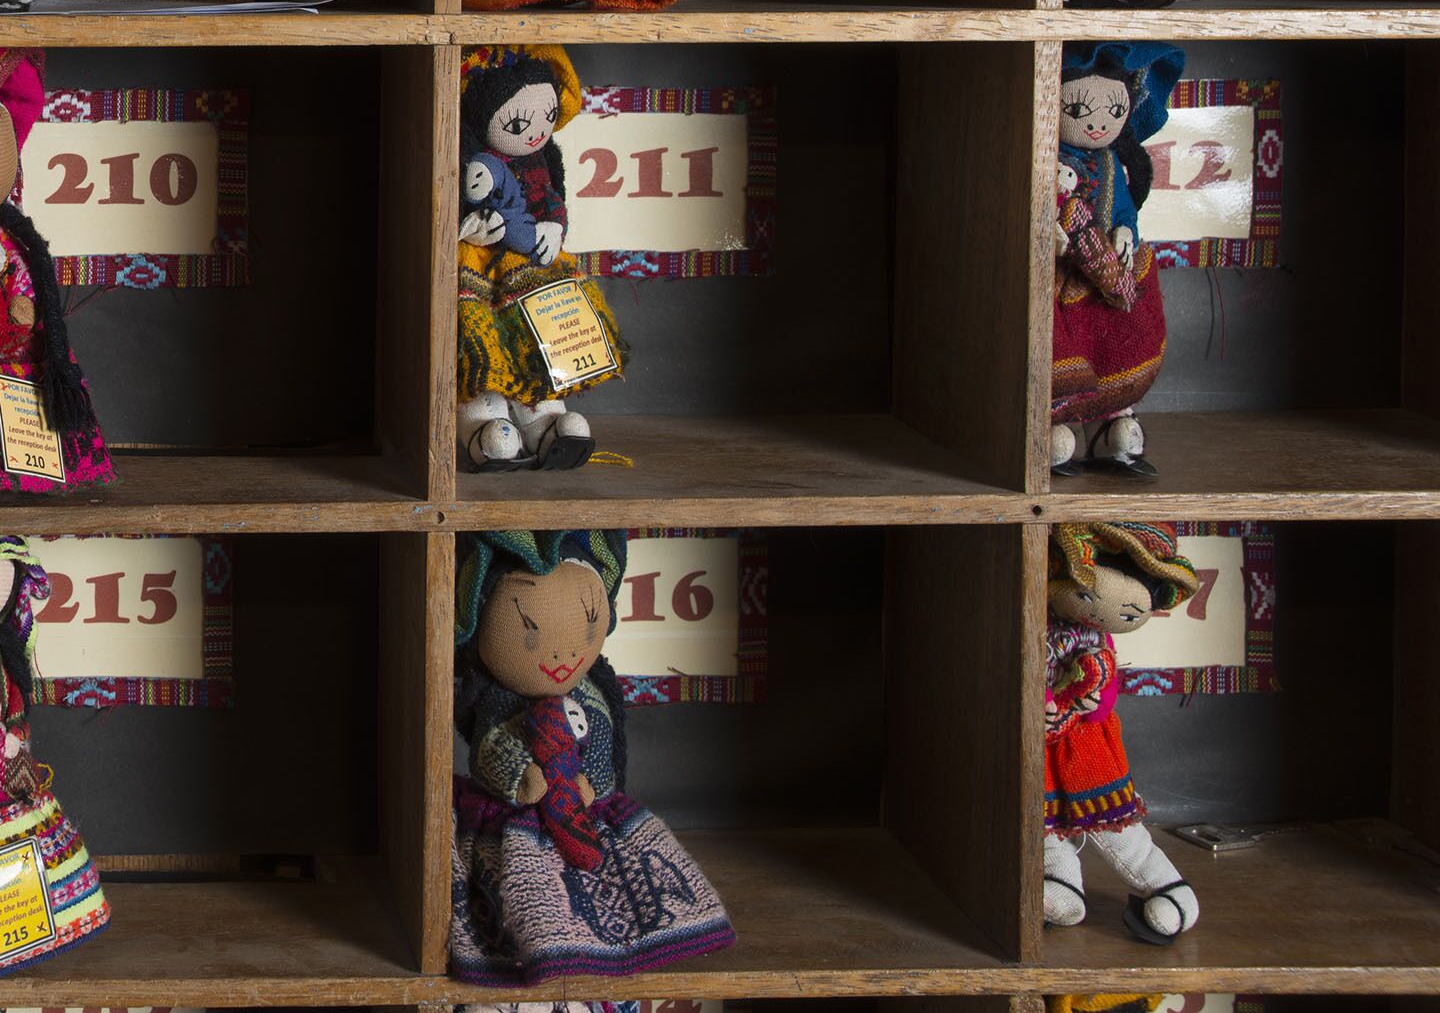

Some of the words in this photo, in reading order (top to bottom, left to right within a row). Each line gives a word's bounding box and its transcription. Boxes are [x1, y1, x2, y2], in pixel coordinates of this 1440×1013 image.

[576, 147, 723, 198] 211
[1141, 141, 1232, 190] 12
[45, 152, 197, 206] 210
[538, 292, 552, 302] POR
[536, 304, 554, 315] Dejar
[551, 307, 579, 321] recepción
[559, 318, 580, 331] PLEASE
[550, 335, 567, 346] Leave
[569, 331, 579, 340] the
[580, 327, 590, 336] key
[551, 349, 561, 358] the
[563, 340, 590, 355] reception
[591, 336, 602, 345] desk
[573, 353, 596, 371] 211
[8, 383, 20, 391] POR
[21, 387, 36, 395] FAVO
[4, 393, 19, 402] Dejar
[20, 417, 40, 427] PLEASE
[9, 426, 25, 435] Leave
[36, 432, 46, 440] key
[18, 440, 43, 450] reception
[45, 444, 56, 452] desk
[25, 453, 45, 468] 210
[35, 570, 177, 624] 215
[621, 571, 714, 621] 16
[4, 903, 16, 913] the
[16, 899, 29, 909] key
[30, 896, 38, 904] at
[28, 905, 43, 917] desk
[3, 926, 29, 946] 215
